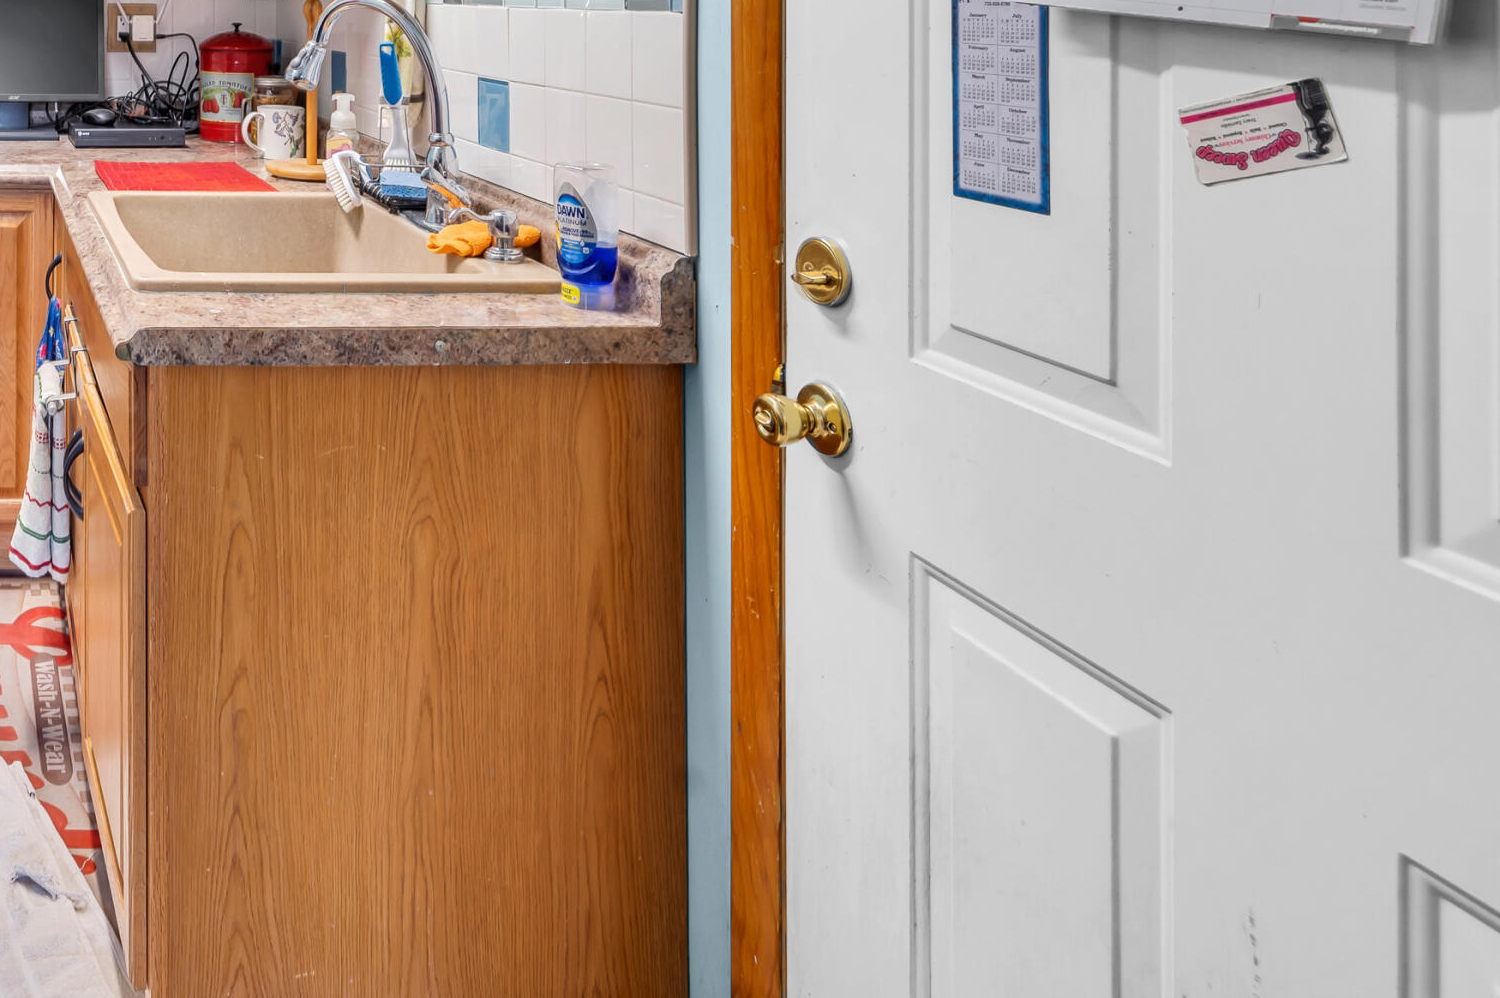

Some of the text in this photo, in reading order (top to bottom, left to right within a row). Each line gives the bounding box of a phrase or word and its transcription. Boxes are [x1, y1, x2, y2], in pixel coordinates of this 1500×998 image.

[1196, 129, 1301, 170] Queen Sweep
[557, 204, 585, 219] DAWN
[34, 659, 68, 775] Wash-N-Wear
